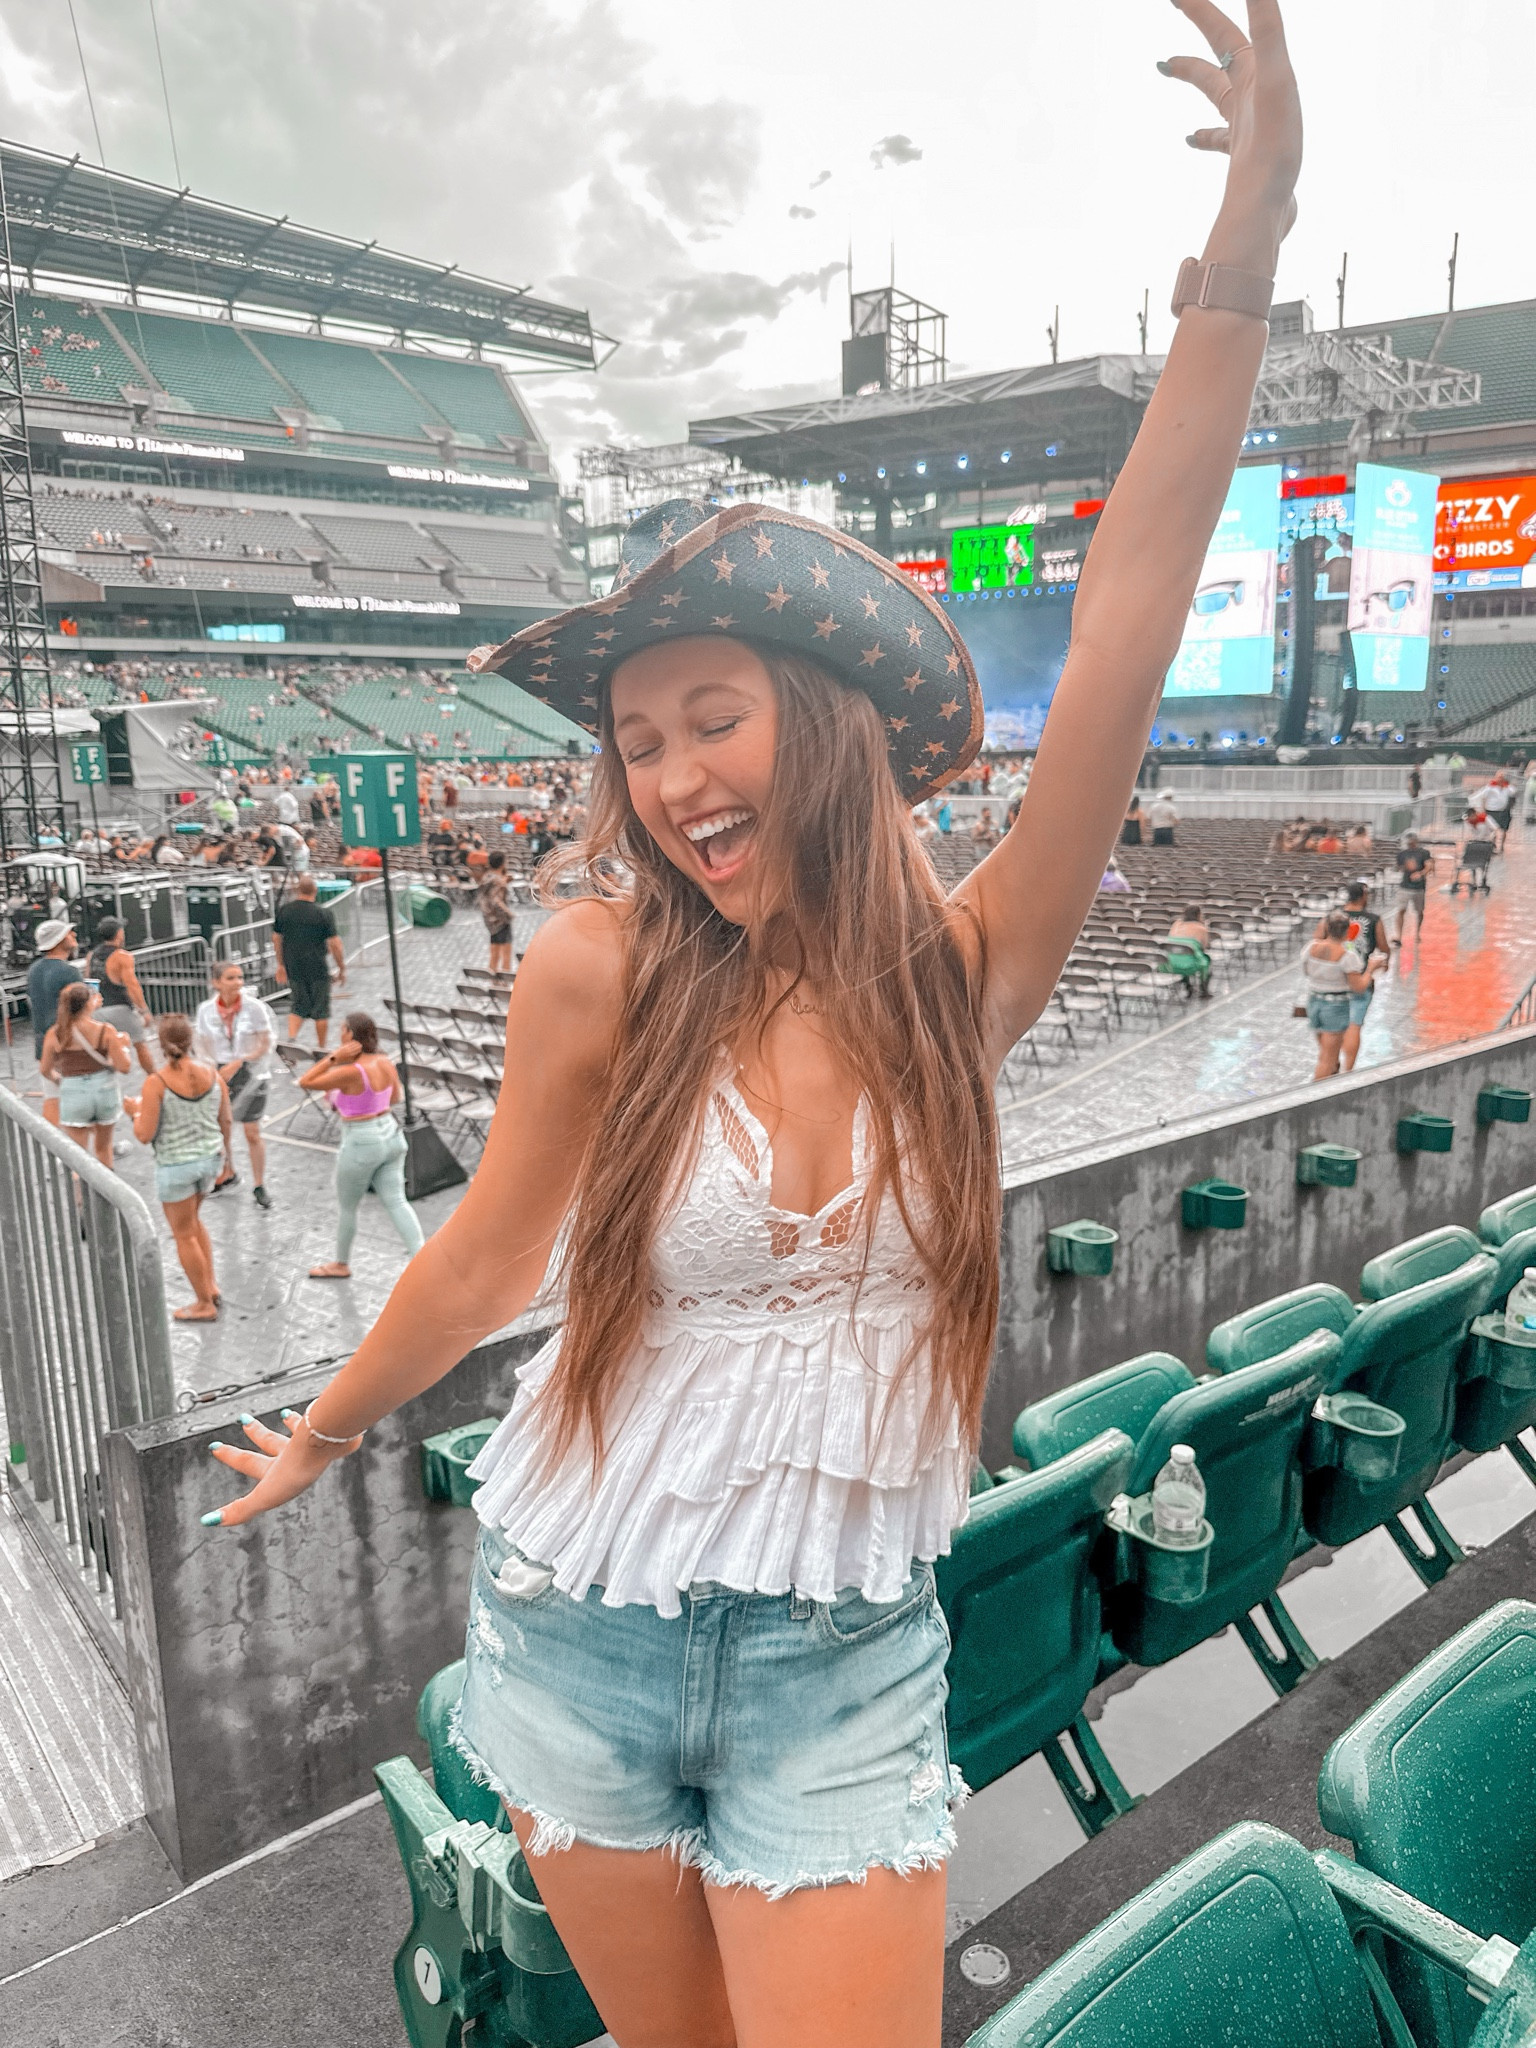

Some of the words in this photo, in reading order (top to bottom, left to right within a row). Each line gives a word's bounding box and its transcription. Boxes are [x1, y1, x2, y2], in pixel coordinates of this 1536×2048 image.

[62, 431, 117, 448] WELCOME
[117, 437, 134, 449] TO
[1455, 539, 1515, 558] BIRDS
[343, 598, 359, 610] TO
[72, 748, 80, 763] F
[87, 747, 98, 763] F
[74, 765, 83, 780] 2
[89, 764, 102, 780] 2
[347, 763, 363, 797] F
[386, 763, 405, 797] F
[352, 804, 366, 838] 1
[392, 804, 407, 837] 1
